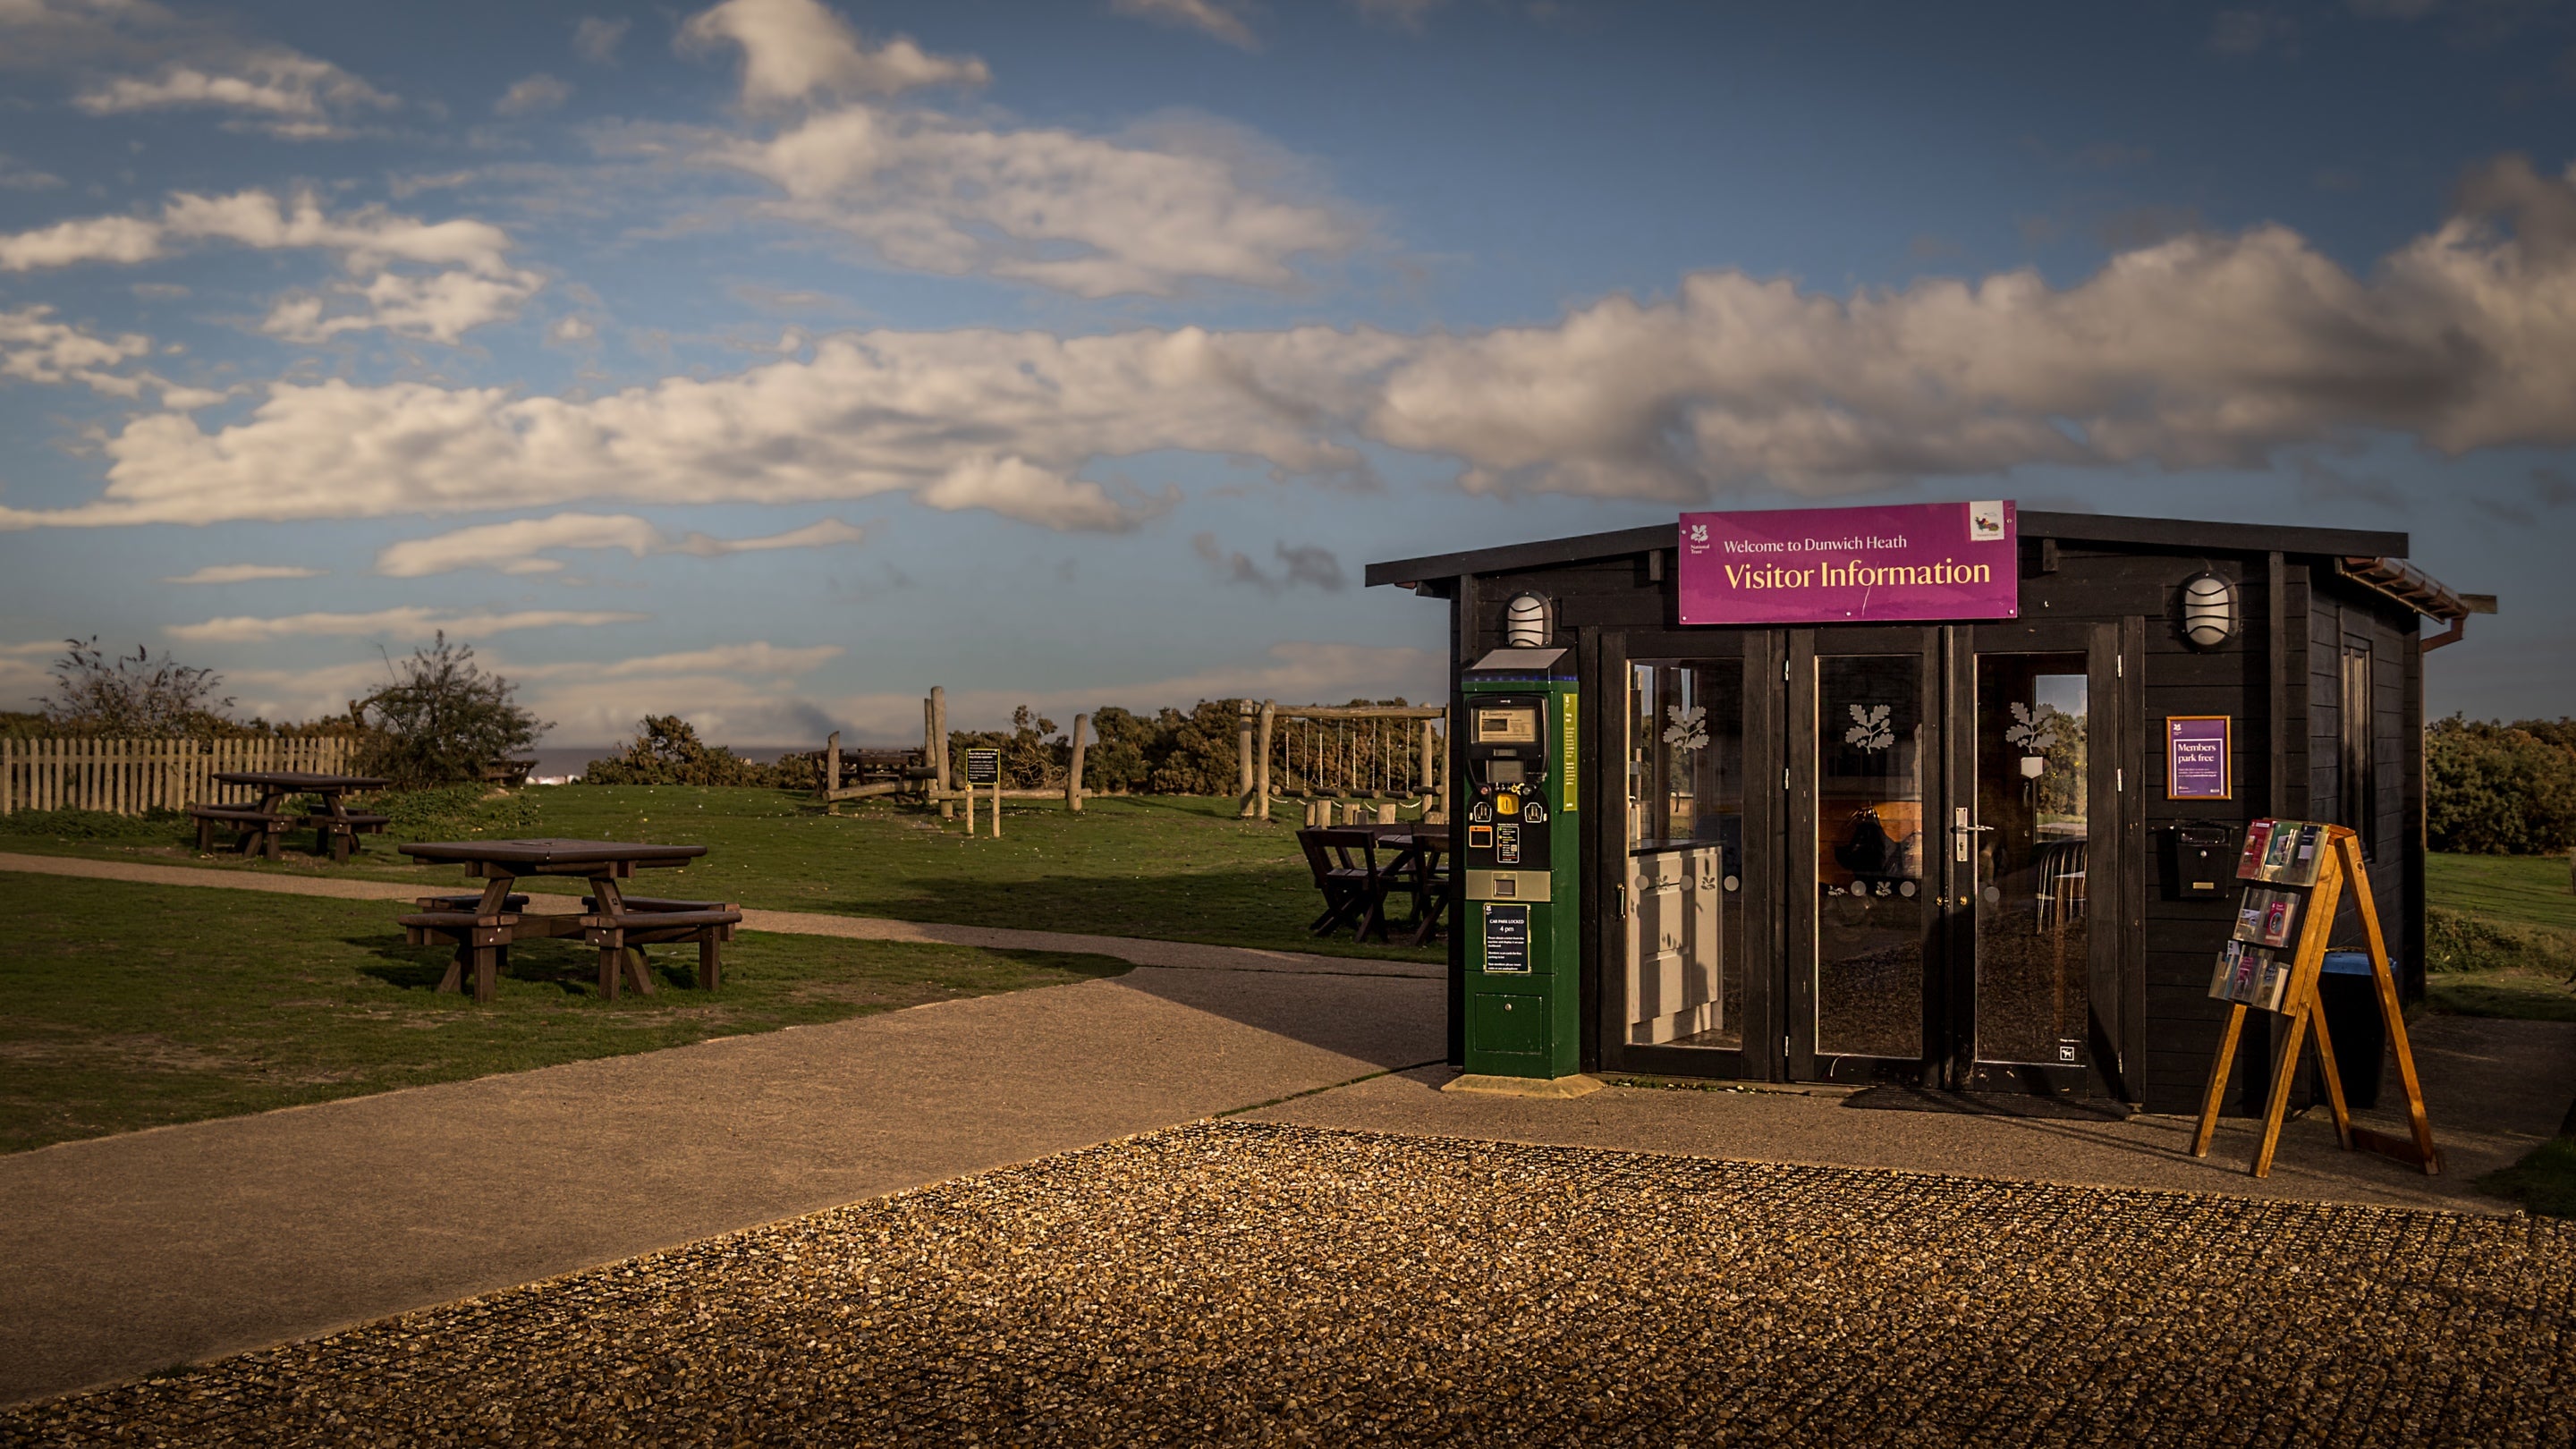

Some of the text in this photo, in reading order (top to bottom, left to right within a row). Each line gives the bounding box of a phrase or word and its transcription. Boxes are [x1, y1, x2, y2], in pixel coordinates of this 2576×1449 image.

[1724, 534, 1907, 553] Welcome to Dunwich Heath
[1724, 557, 1990, 589] Visitor Information
[2178, 743, 2216, 751] Members
[2178, 753, 2215, 764] park free
